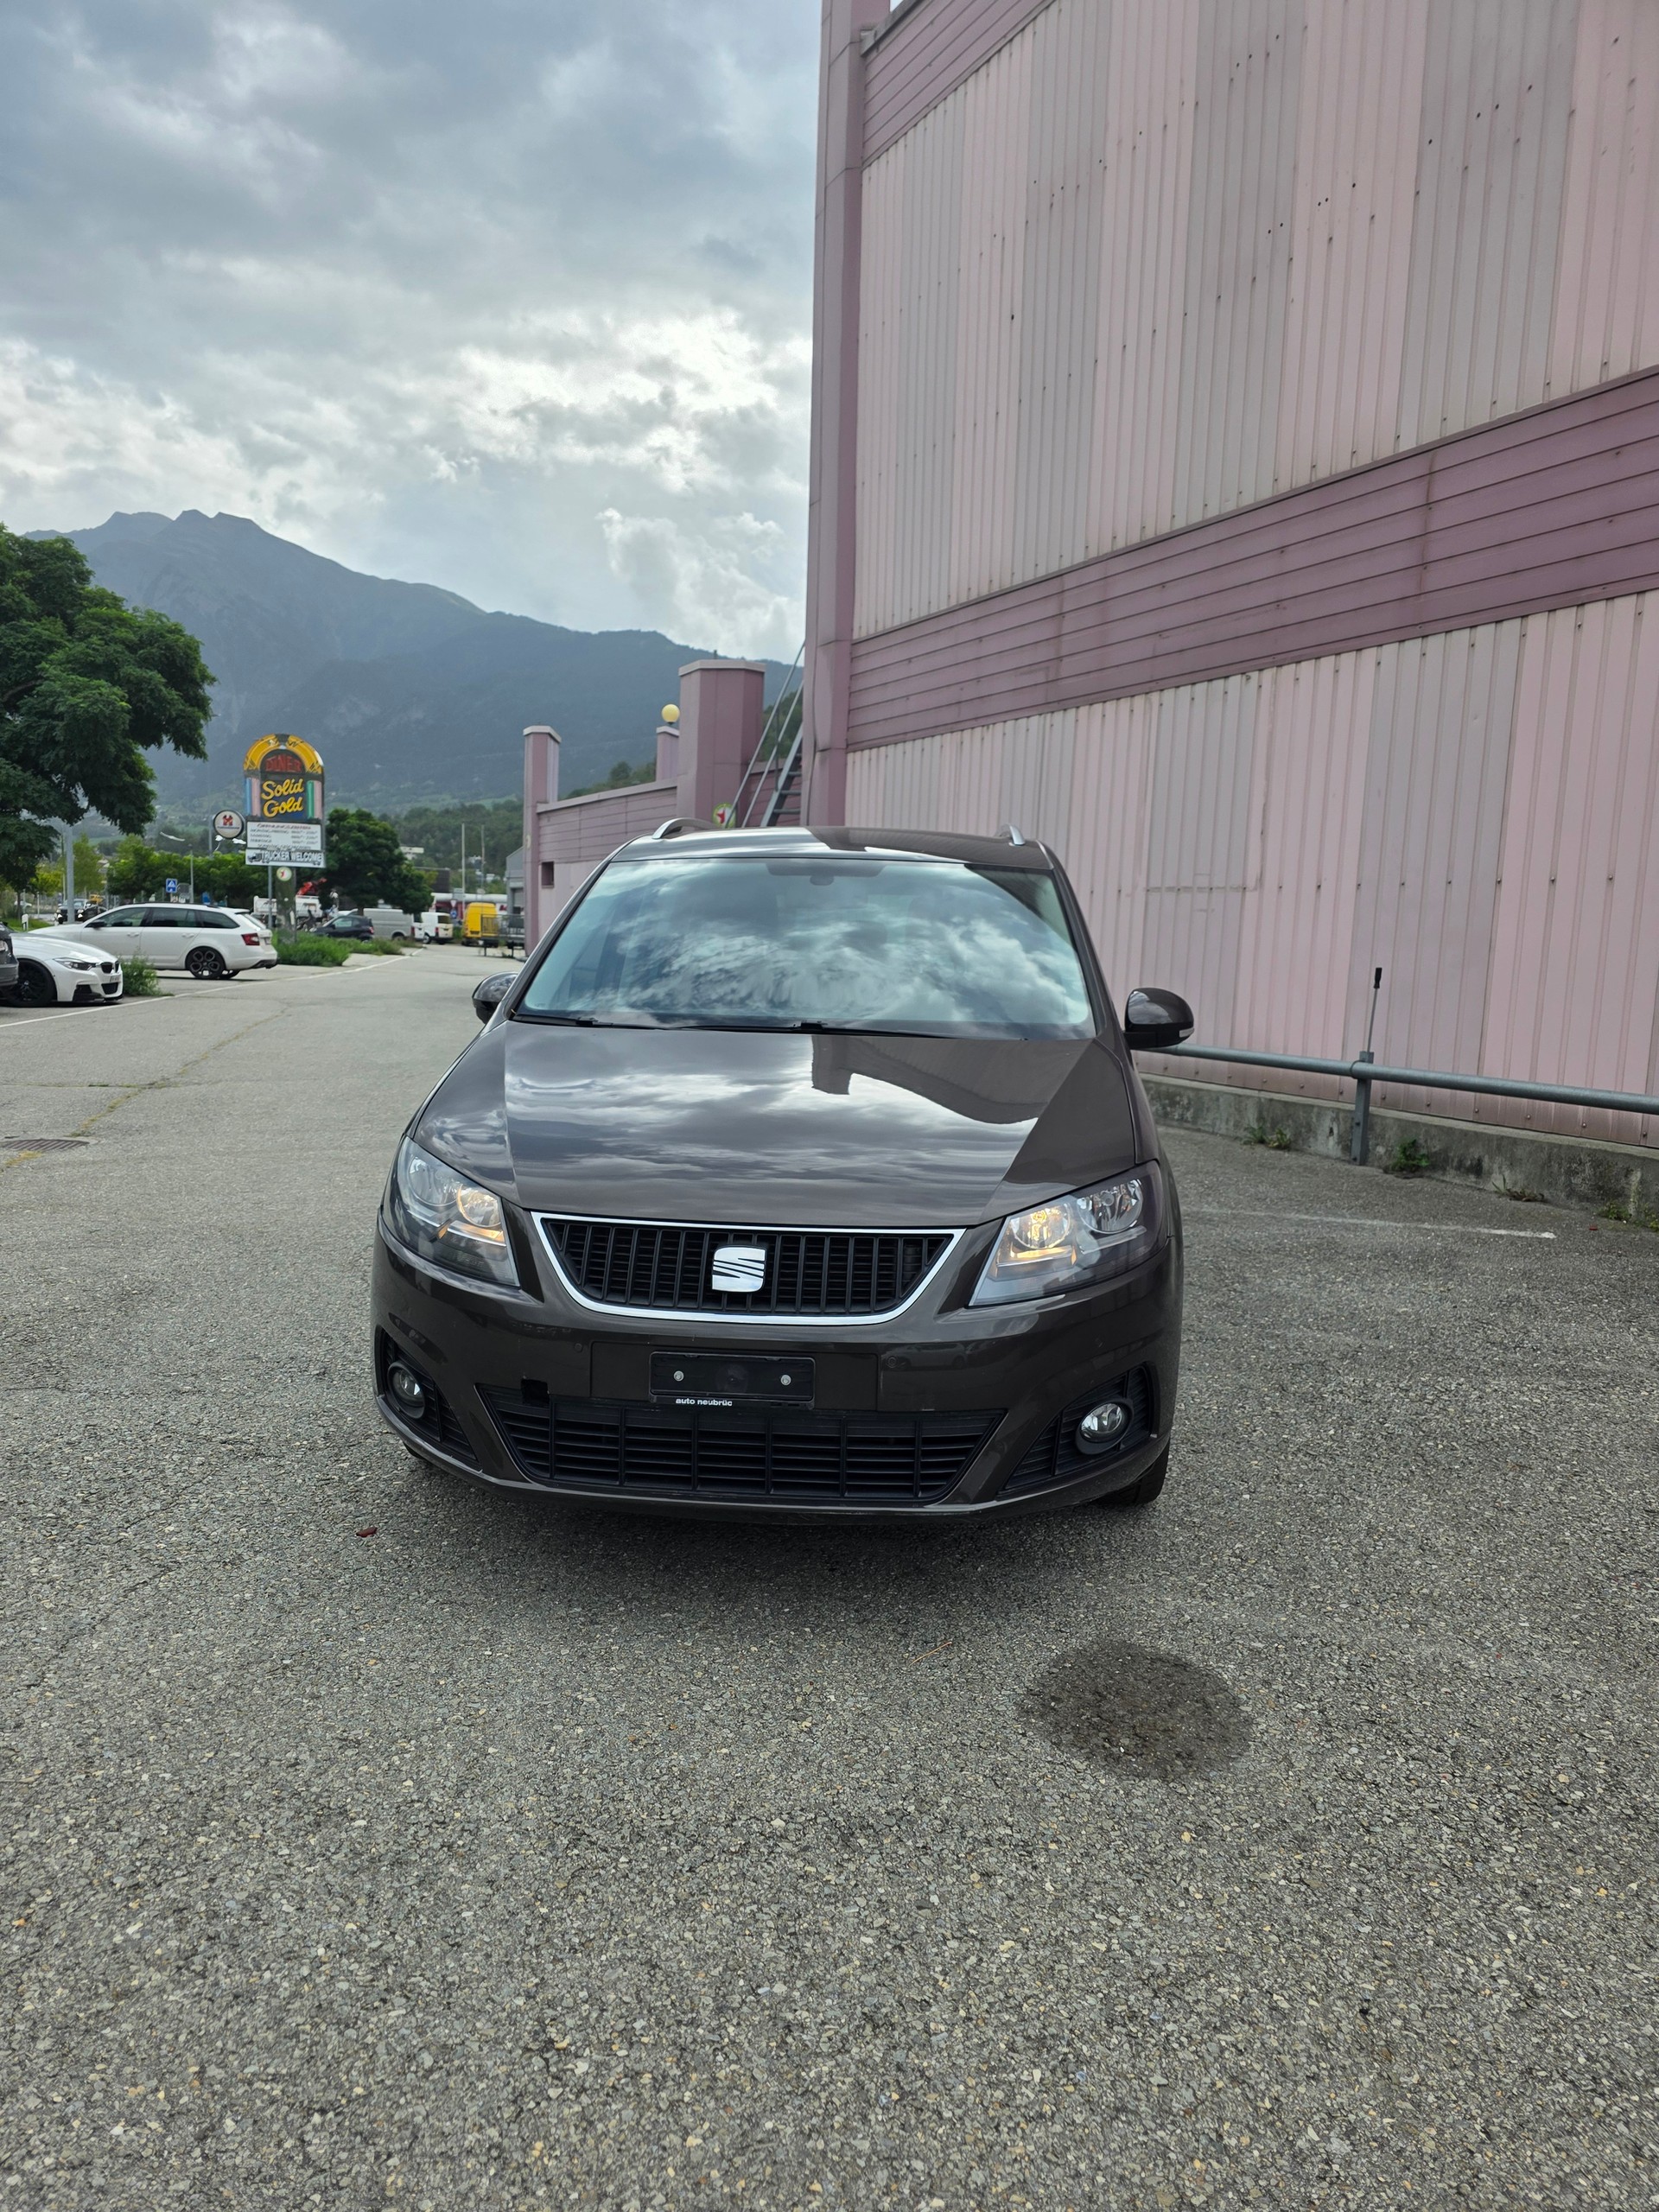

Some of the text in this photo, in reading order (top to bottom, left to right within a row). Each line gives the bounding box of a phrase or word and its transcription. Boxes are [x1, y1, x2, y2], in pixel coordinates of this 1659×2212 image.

[266, 754, 302, 772] DINER
[261, 779, 303, 799] Solid
[264, 797, 303, 817] Gold
[263, 850, 323, 862] TRUCKER WELCOME
